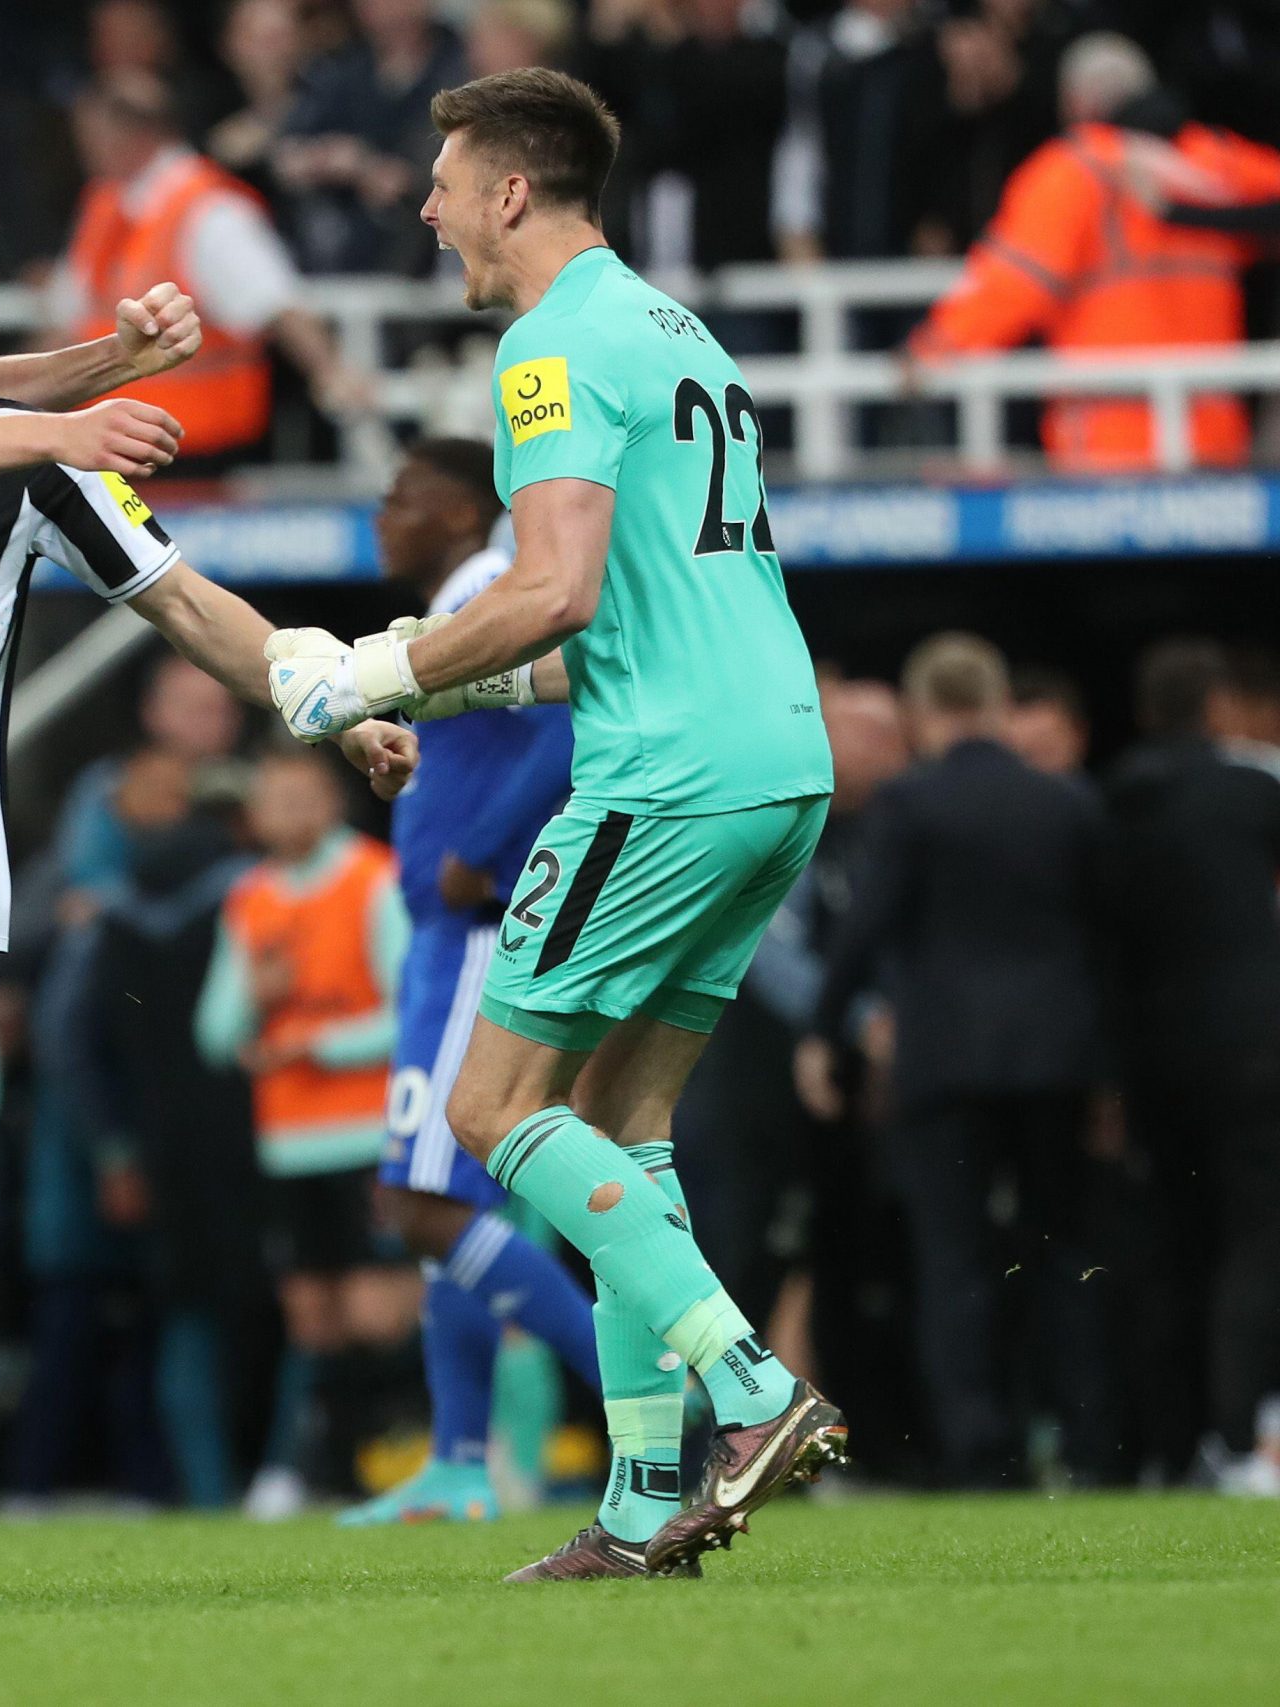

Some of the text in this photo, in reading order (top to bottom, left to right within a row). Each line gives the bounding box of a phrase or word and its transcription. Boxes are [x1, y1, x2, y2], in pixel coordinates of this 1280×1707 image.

[510, 402, 565, 433] noon
[673, 376, 776, 558] 22
[510, 848, 561, 931] 2
